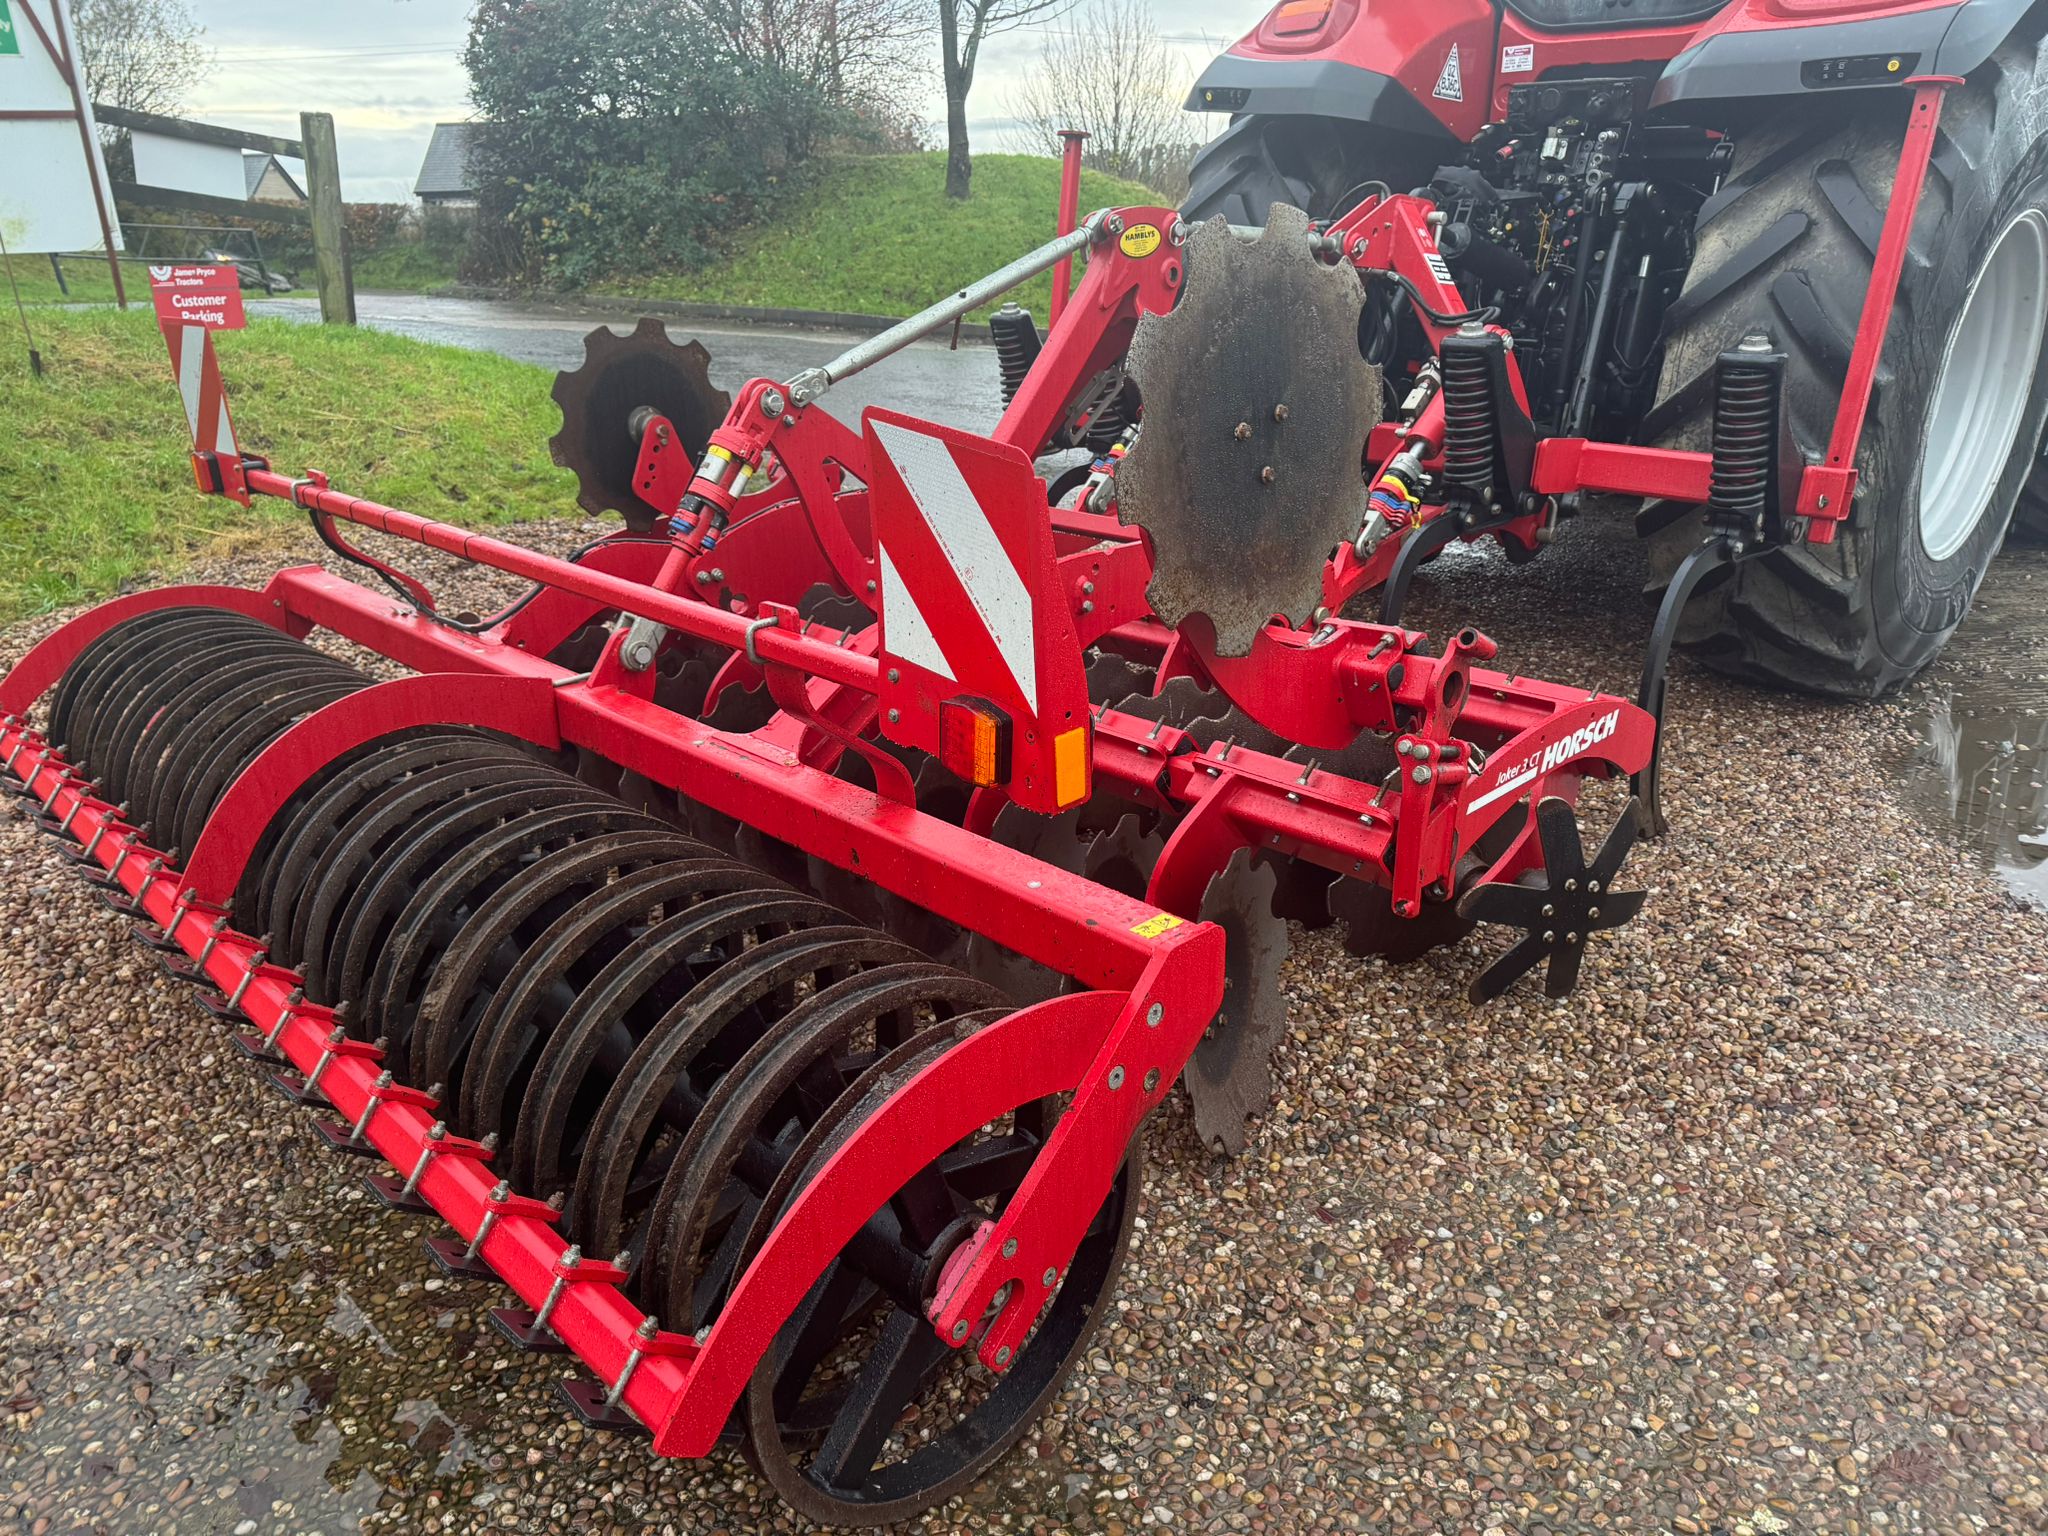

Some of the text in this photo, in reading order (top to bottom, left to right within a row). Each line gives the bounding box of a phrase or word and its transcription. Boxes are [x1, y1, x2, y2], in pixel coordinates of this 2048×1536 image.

[1125, 230, 1155, 241] HAMBLYS
[175, 278, 204, 286] Tractors
[172, 294, 227, 308] Customer
[1541, 708, 1620, 774] HORSCH
[1495, 750, 1542, 787] Joker 3 CT
